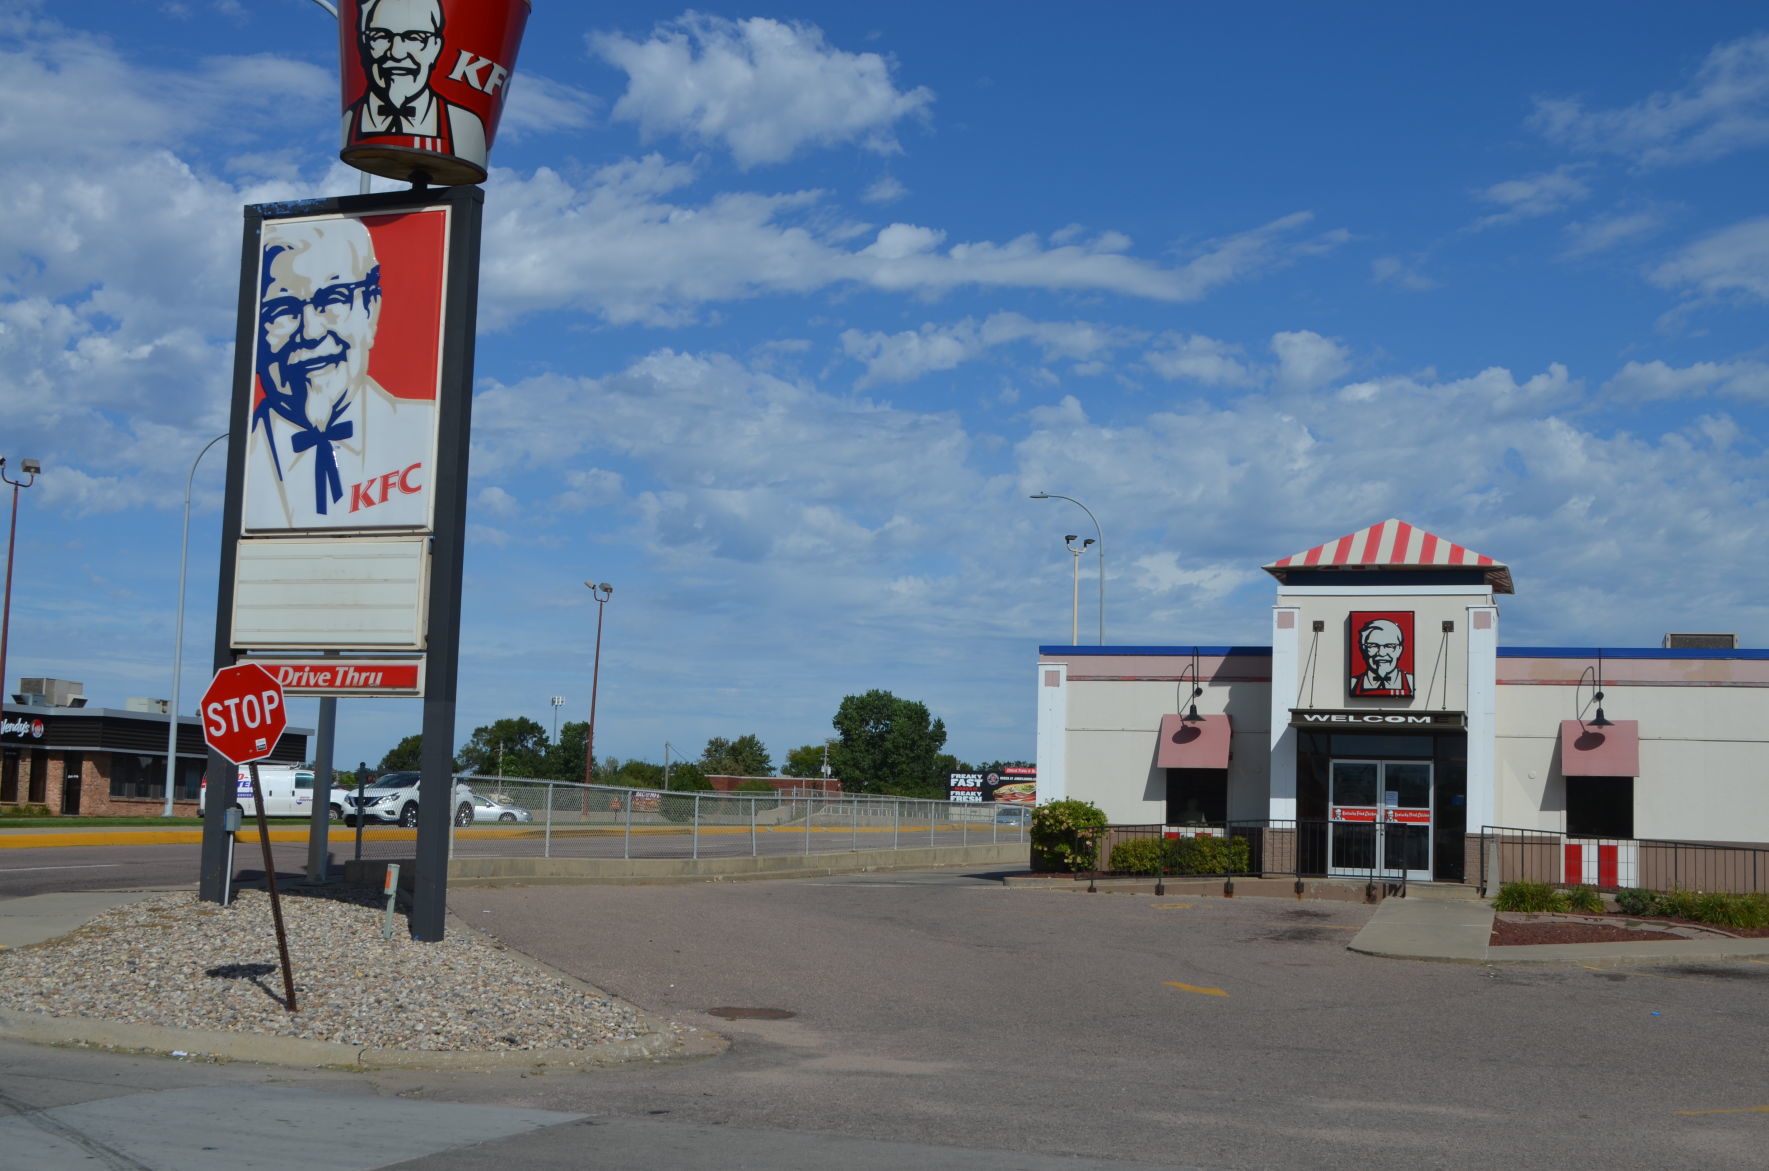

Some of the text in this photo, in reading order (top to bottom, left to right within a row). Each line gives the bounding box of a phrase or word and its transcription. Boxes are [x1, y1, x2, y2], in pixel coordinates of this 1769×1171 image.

[348, 462, 422, 514] KFC
[277, 666, 383, 687] Drive Thru
[207, 689, 280, 737] STOP
[1303, 714, 1431, 724] WELCOM
[950, 779, 983, 787] FAST
